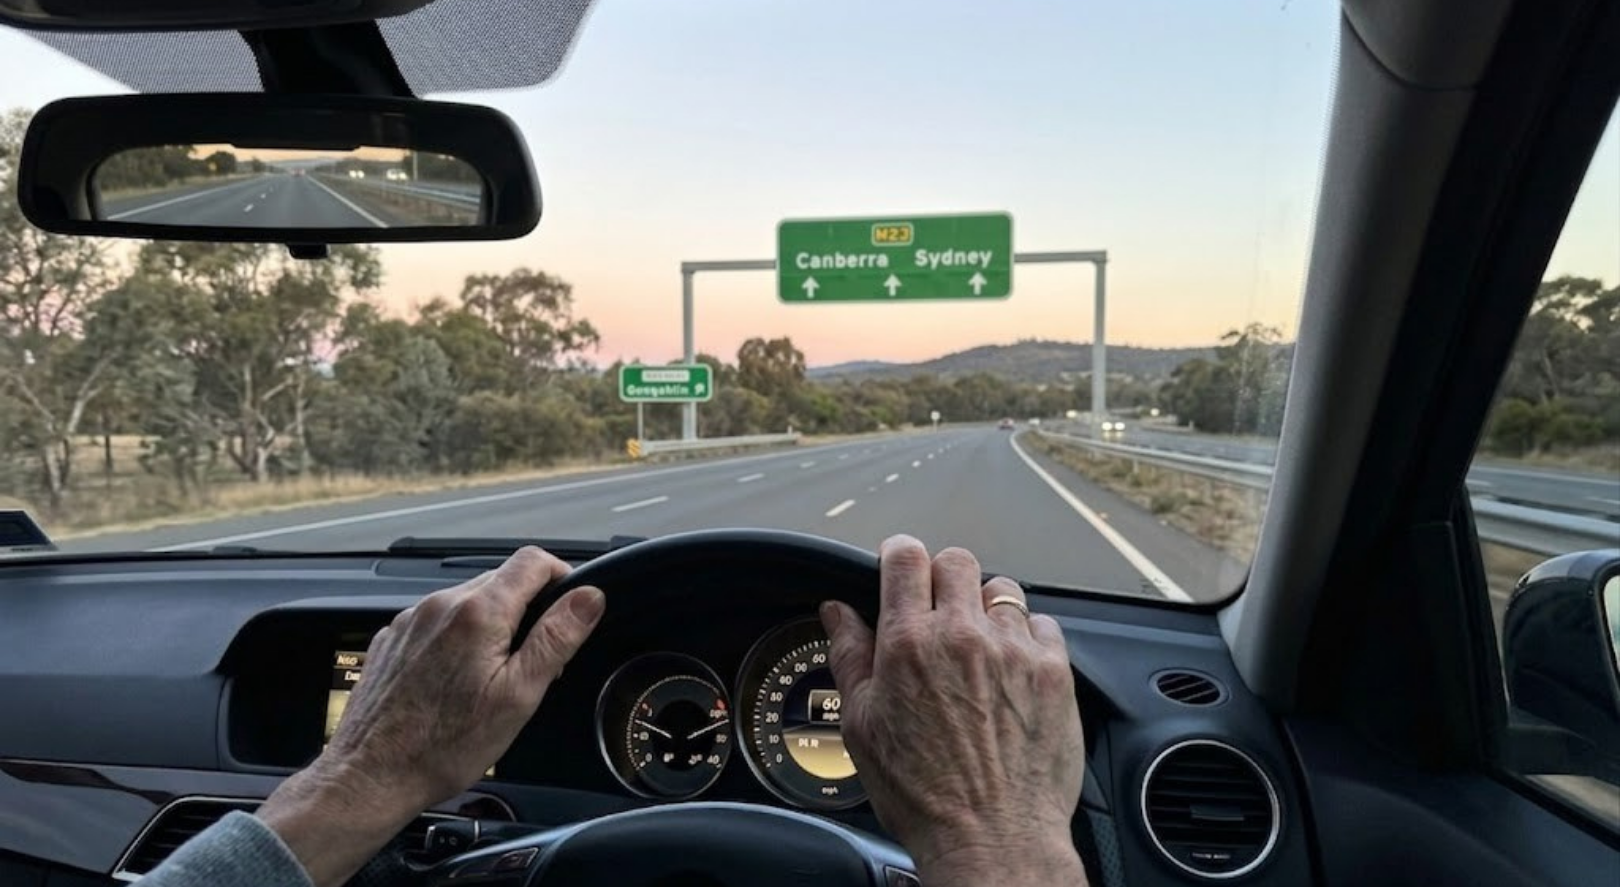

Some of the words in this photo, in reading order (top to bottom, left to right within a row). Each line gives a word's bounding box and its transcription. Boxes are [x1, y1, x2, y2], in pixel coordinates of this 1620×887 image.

[796, 252, 889, 269] Canberra
[914, 248, 992, 270] Sydney
[812, 653, 826, 664] 60
[822, 697, 841, 710] 60
[765, 712, 779, 723] 20
[769, 734, 780, 744] 10
[776, 753, 783, 763] 0
